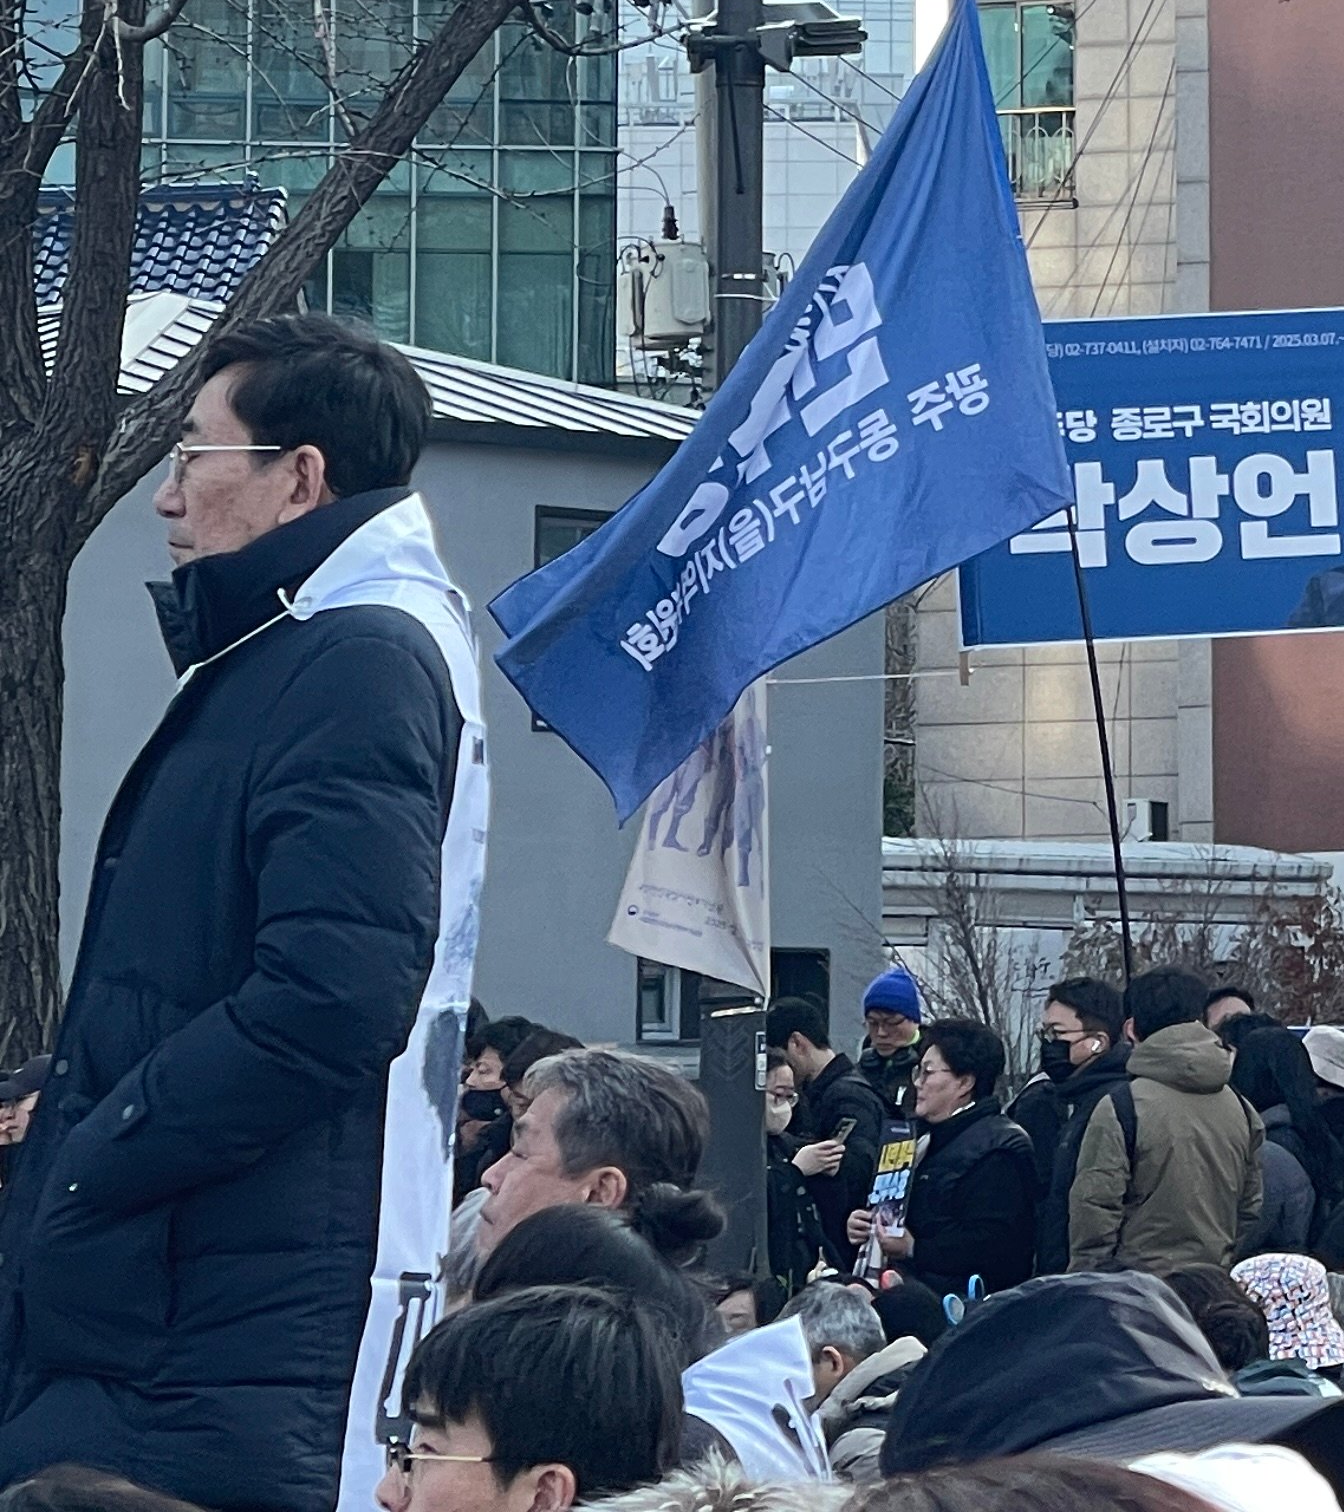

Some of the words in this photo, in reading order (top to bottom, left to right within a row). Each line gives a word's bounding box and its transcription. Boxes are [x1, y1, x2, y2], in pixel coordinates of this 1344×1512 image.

[1056, 408, 1098, 444] 당
[1111, 404, 1204, 442] 종로구
[1209, 396, 1333, 436] 국회의원
